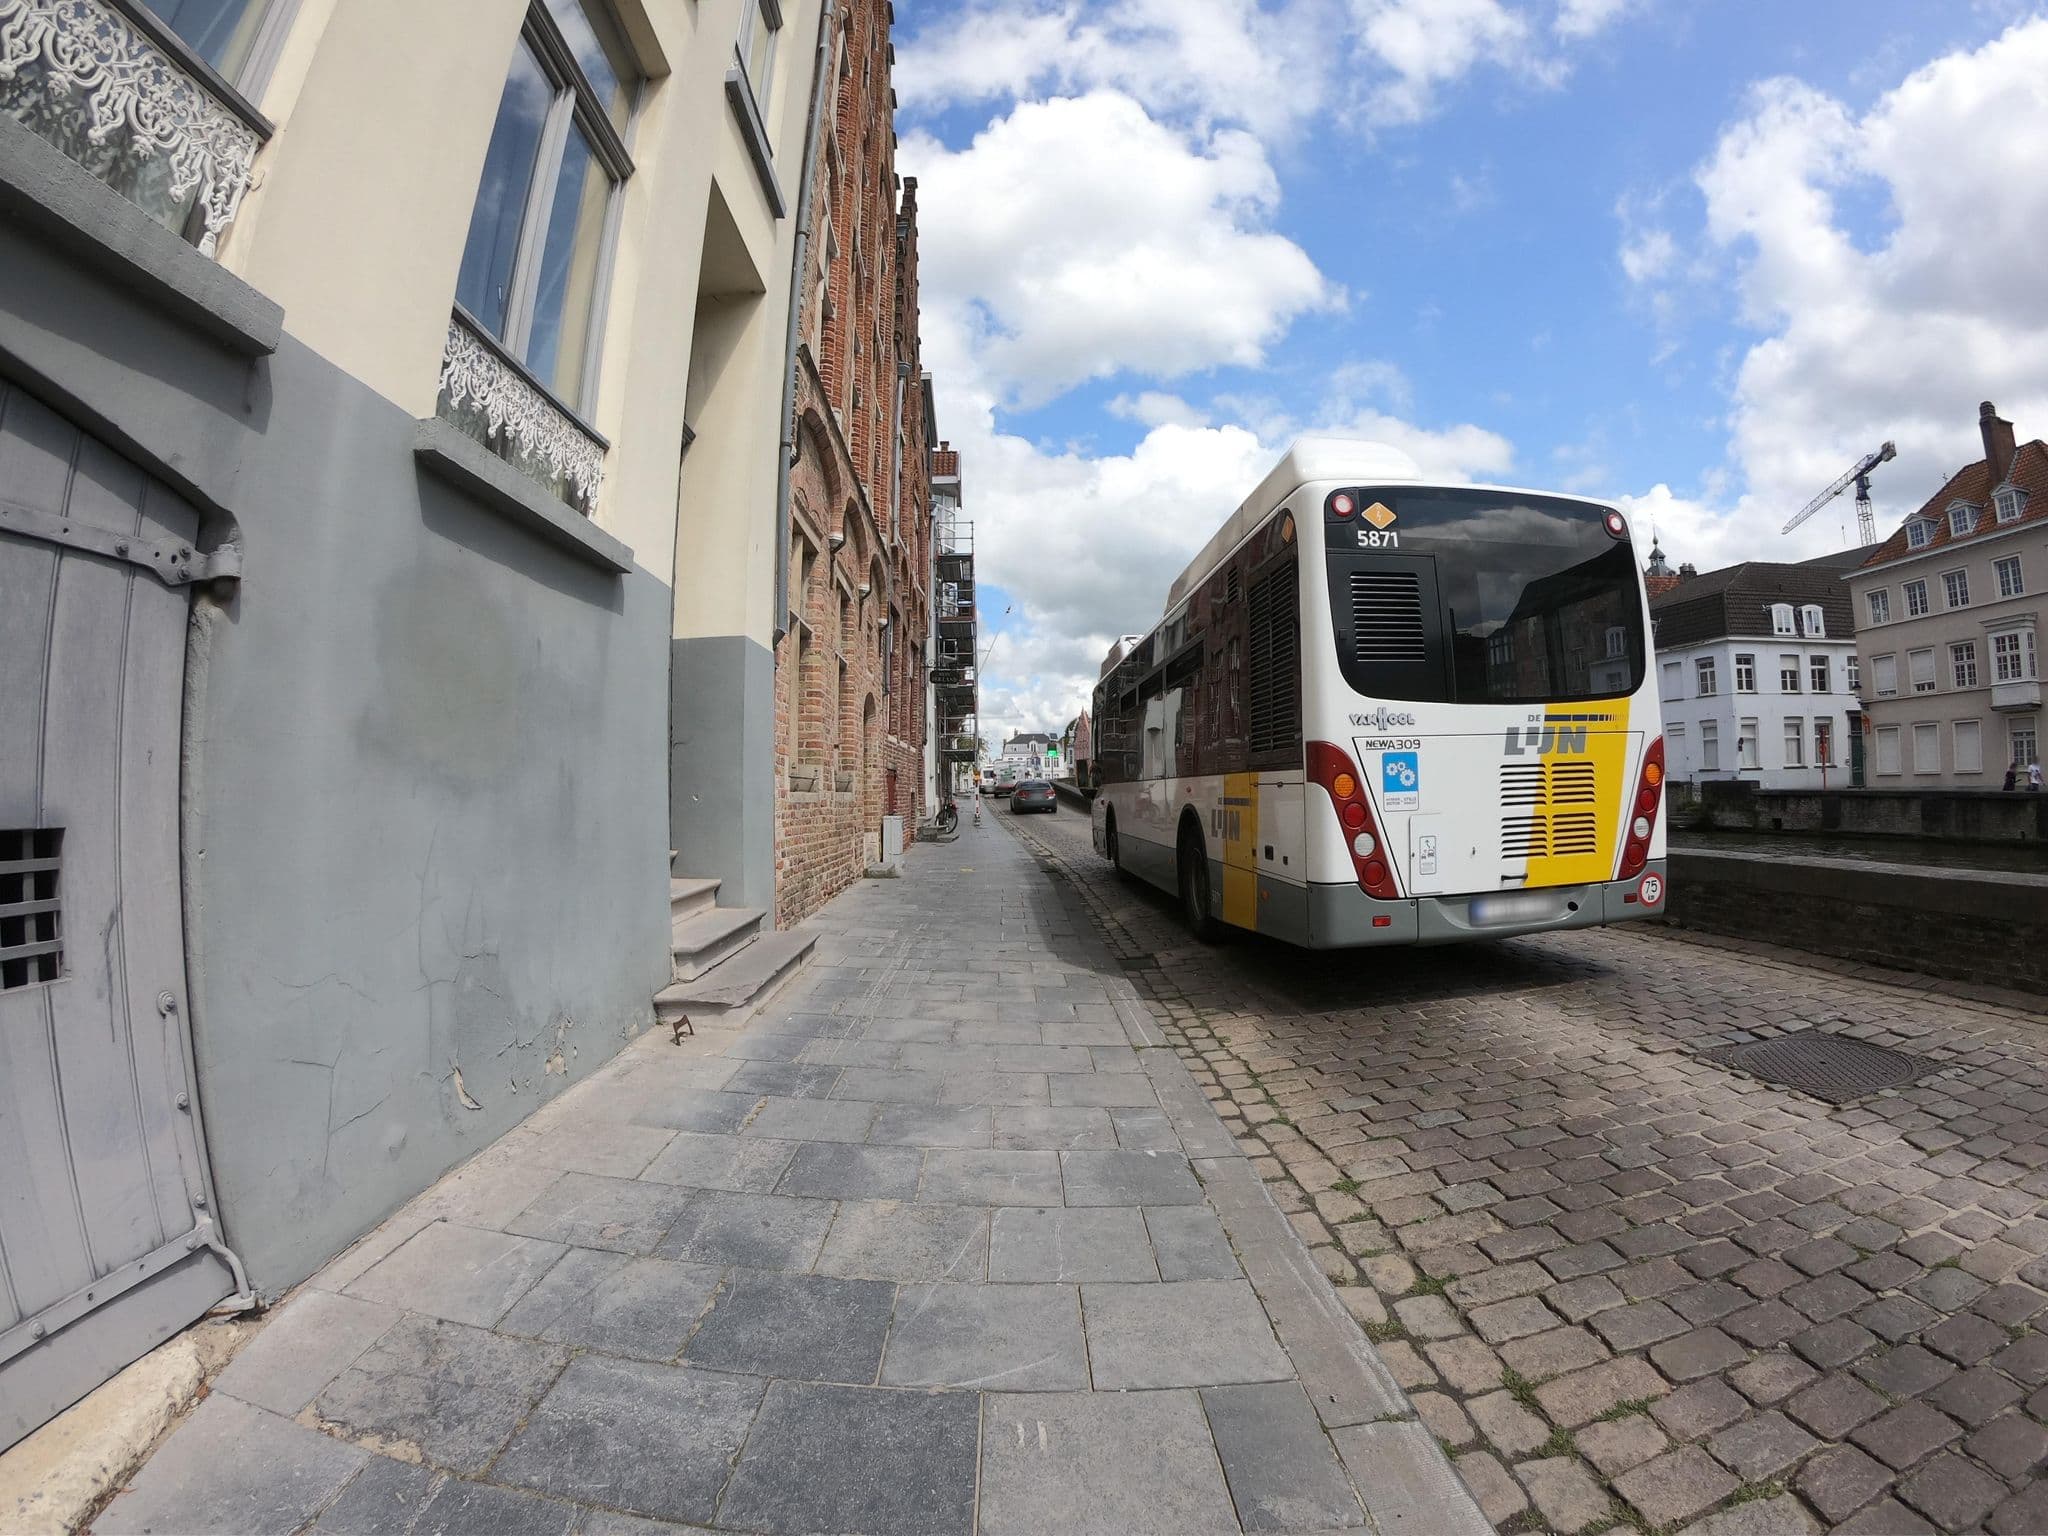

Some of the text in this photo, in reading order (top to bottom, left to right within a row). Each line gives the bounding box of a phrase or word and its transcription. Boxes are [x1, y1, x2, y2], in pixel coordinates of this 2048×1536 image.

[1357, 530, 1399, 548] 5871
[1527, 714, 1542, 722] DE
[1504, 726, 1587, 756] LIJN
[1645, 880, 1658, 894] 75
